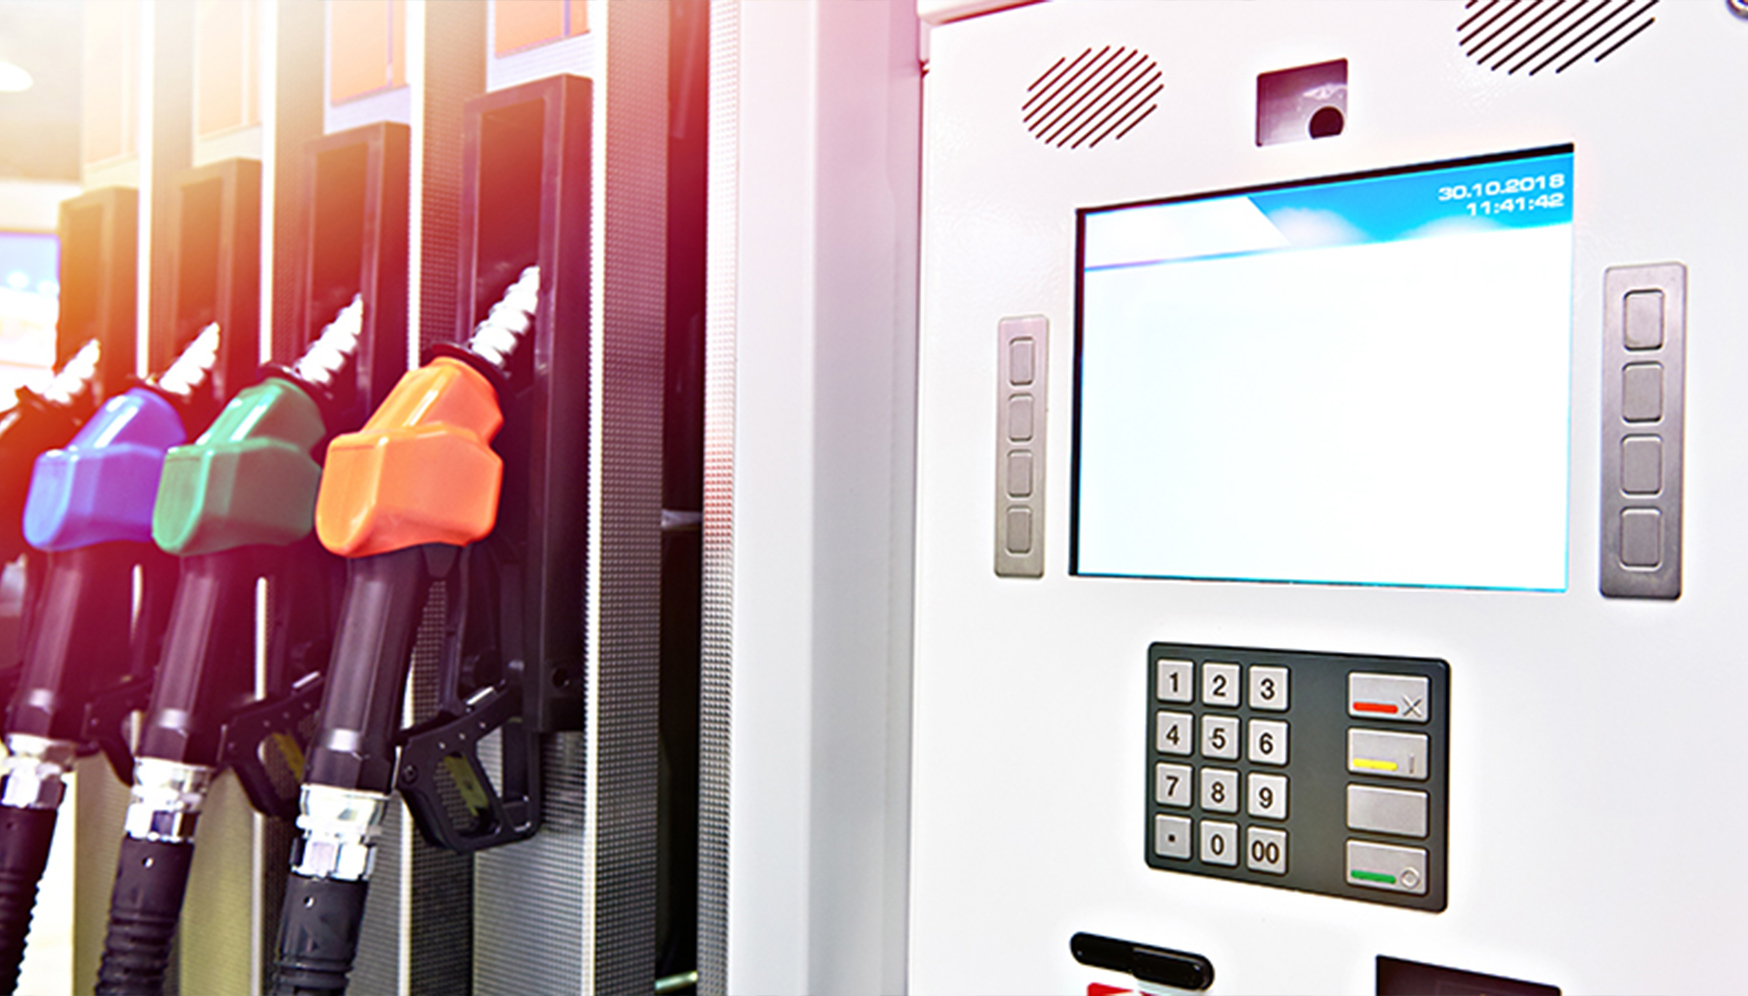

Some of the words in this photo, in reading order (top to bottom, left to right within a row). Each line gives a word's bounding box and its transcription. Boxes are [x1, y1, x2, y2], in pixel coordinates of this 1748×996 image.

[1438, 173, 1565, 201] 30.10.2018
[1466, 193, 1564, 216] 11:41:42
[1168, 672, 1179, 693] 1
[1212, 674, 1227, 697] 2
[1260, 678, 1275, 700] 3
[1166, 724, 1180, 745] 4
[1211, 728, 1226, 750] 5
[1259, 732, 1274, 755] 6
[1166, 775, 1180, 797] 7
[1211, 781, 1225, 804] 8
[1258, 787, 1273, 809] 9
[1210, 833, 1225, 856] 0
[1251, 840, 1280, 864] 00
